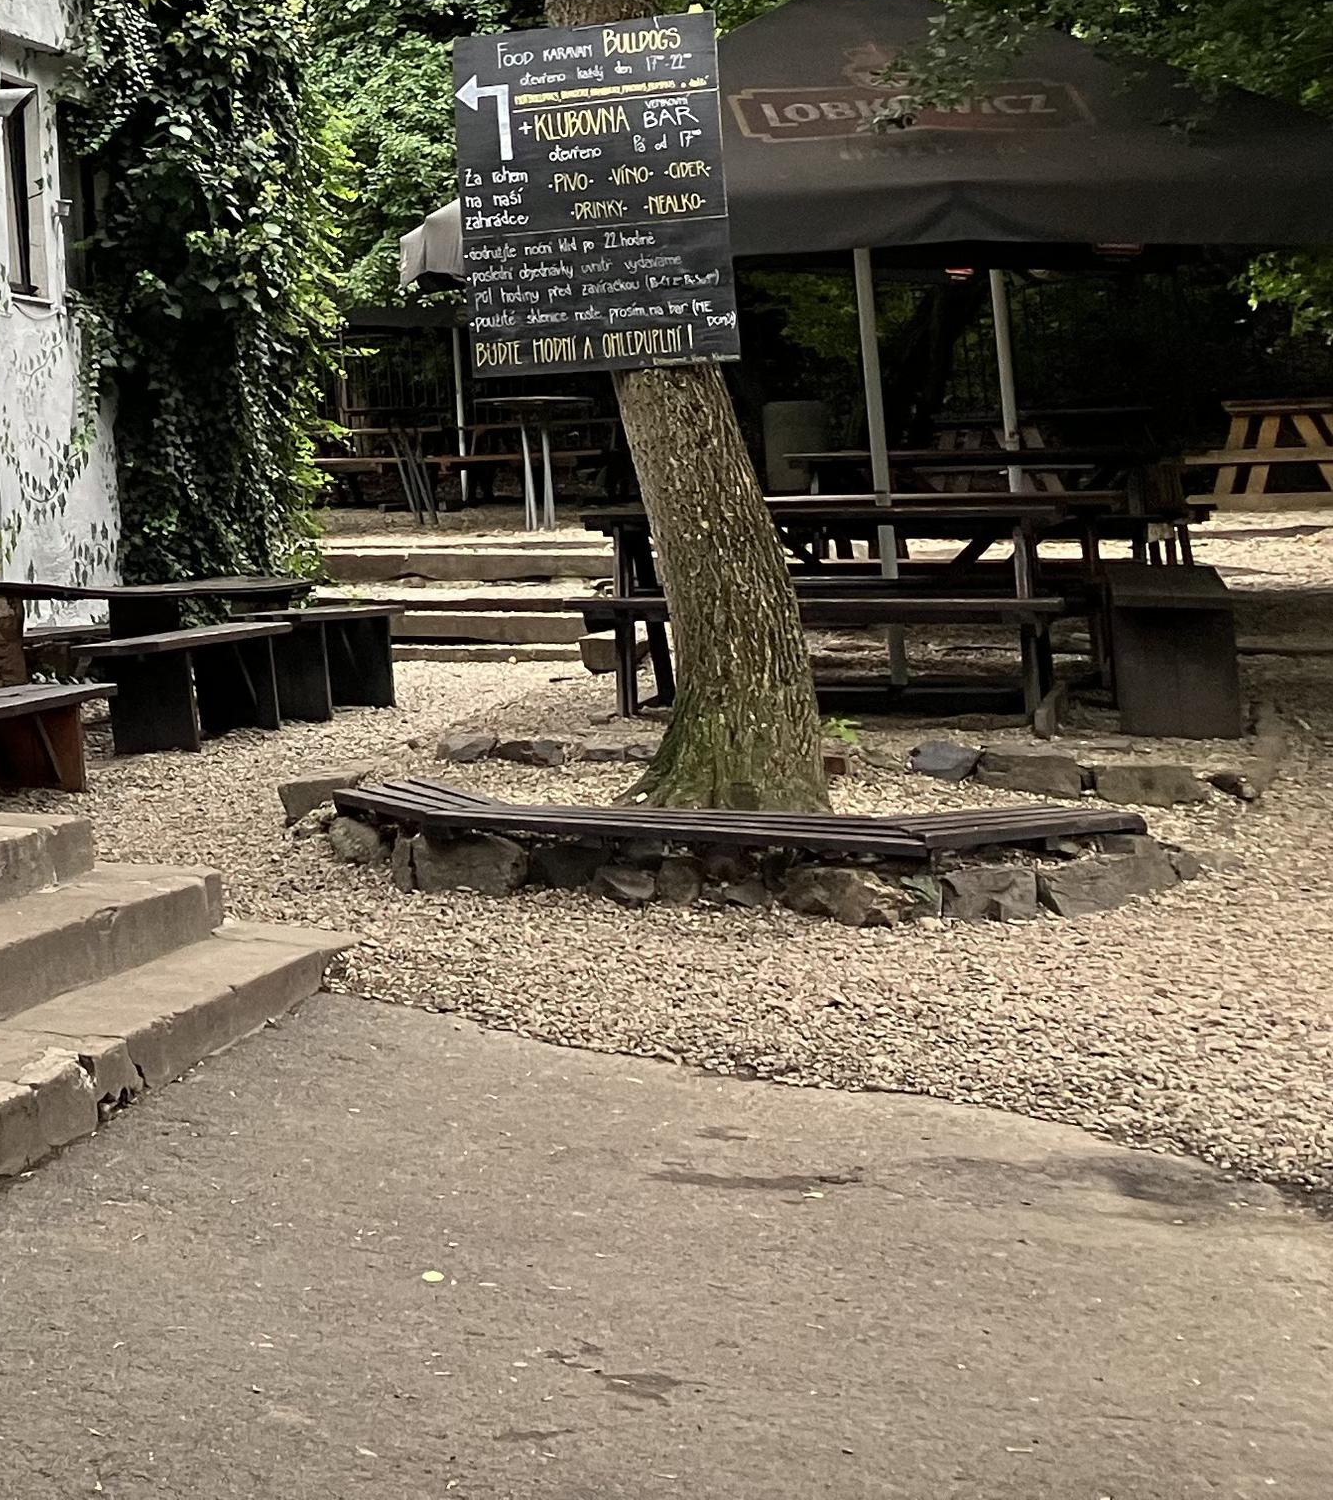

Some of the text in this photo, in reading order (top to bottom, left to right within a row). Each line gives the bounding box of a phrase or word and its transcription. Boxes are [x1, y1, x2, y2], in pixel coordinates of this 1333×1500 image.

[543, 44, 592, 62] KARAVAN
[602, 27, 681, 57] BULLDOGS
[520, 73, 566, 86] otevřeno
[614, 60, 633, 74] den
[642, 105, 700, 128] BAR
[760, 93, 1058, 129] LOBKWICZ
[549, 144, 602, 163] otevřeno
[632, 134, 646, 153] Pá
[654, 134, 667, 151] od
[464, 166, 529, 188] Za rohem
[465, 187, 525, 209] na naší
[465, 211, 530, 232] zahrádce
[524, 242, 552, 256] noční
[582, 240, 595, 254] po
[603, 231, 618, 249] 22
[471, 265, 514, 287] poslední
[519, 260, 574, 281] objednávky
[624, 253, 682, 275] vydáváme
[500, 284, 539, 304] hodiny
[547, 282, 572, 303] před
[581, 277, 640, 296] zavíračkou
[526, 307, 569, 325] sklenice
[648, 304, 664, 317] na
[667, 301, 688, 316] bar
[533, 335, 577, 364] HODNÍ
[583, 336, 594, 360] A
